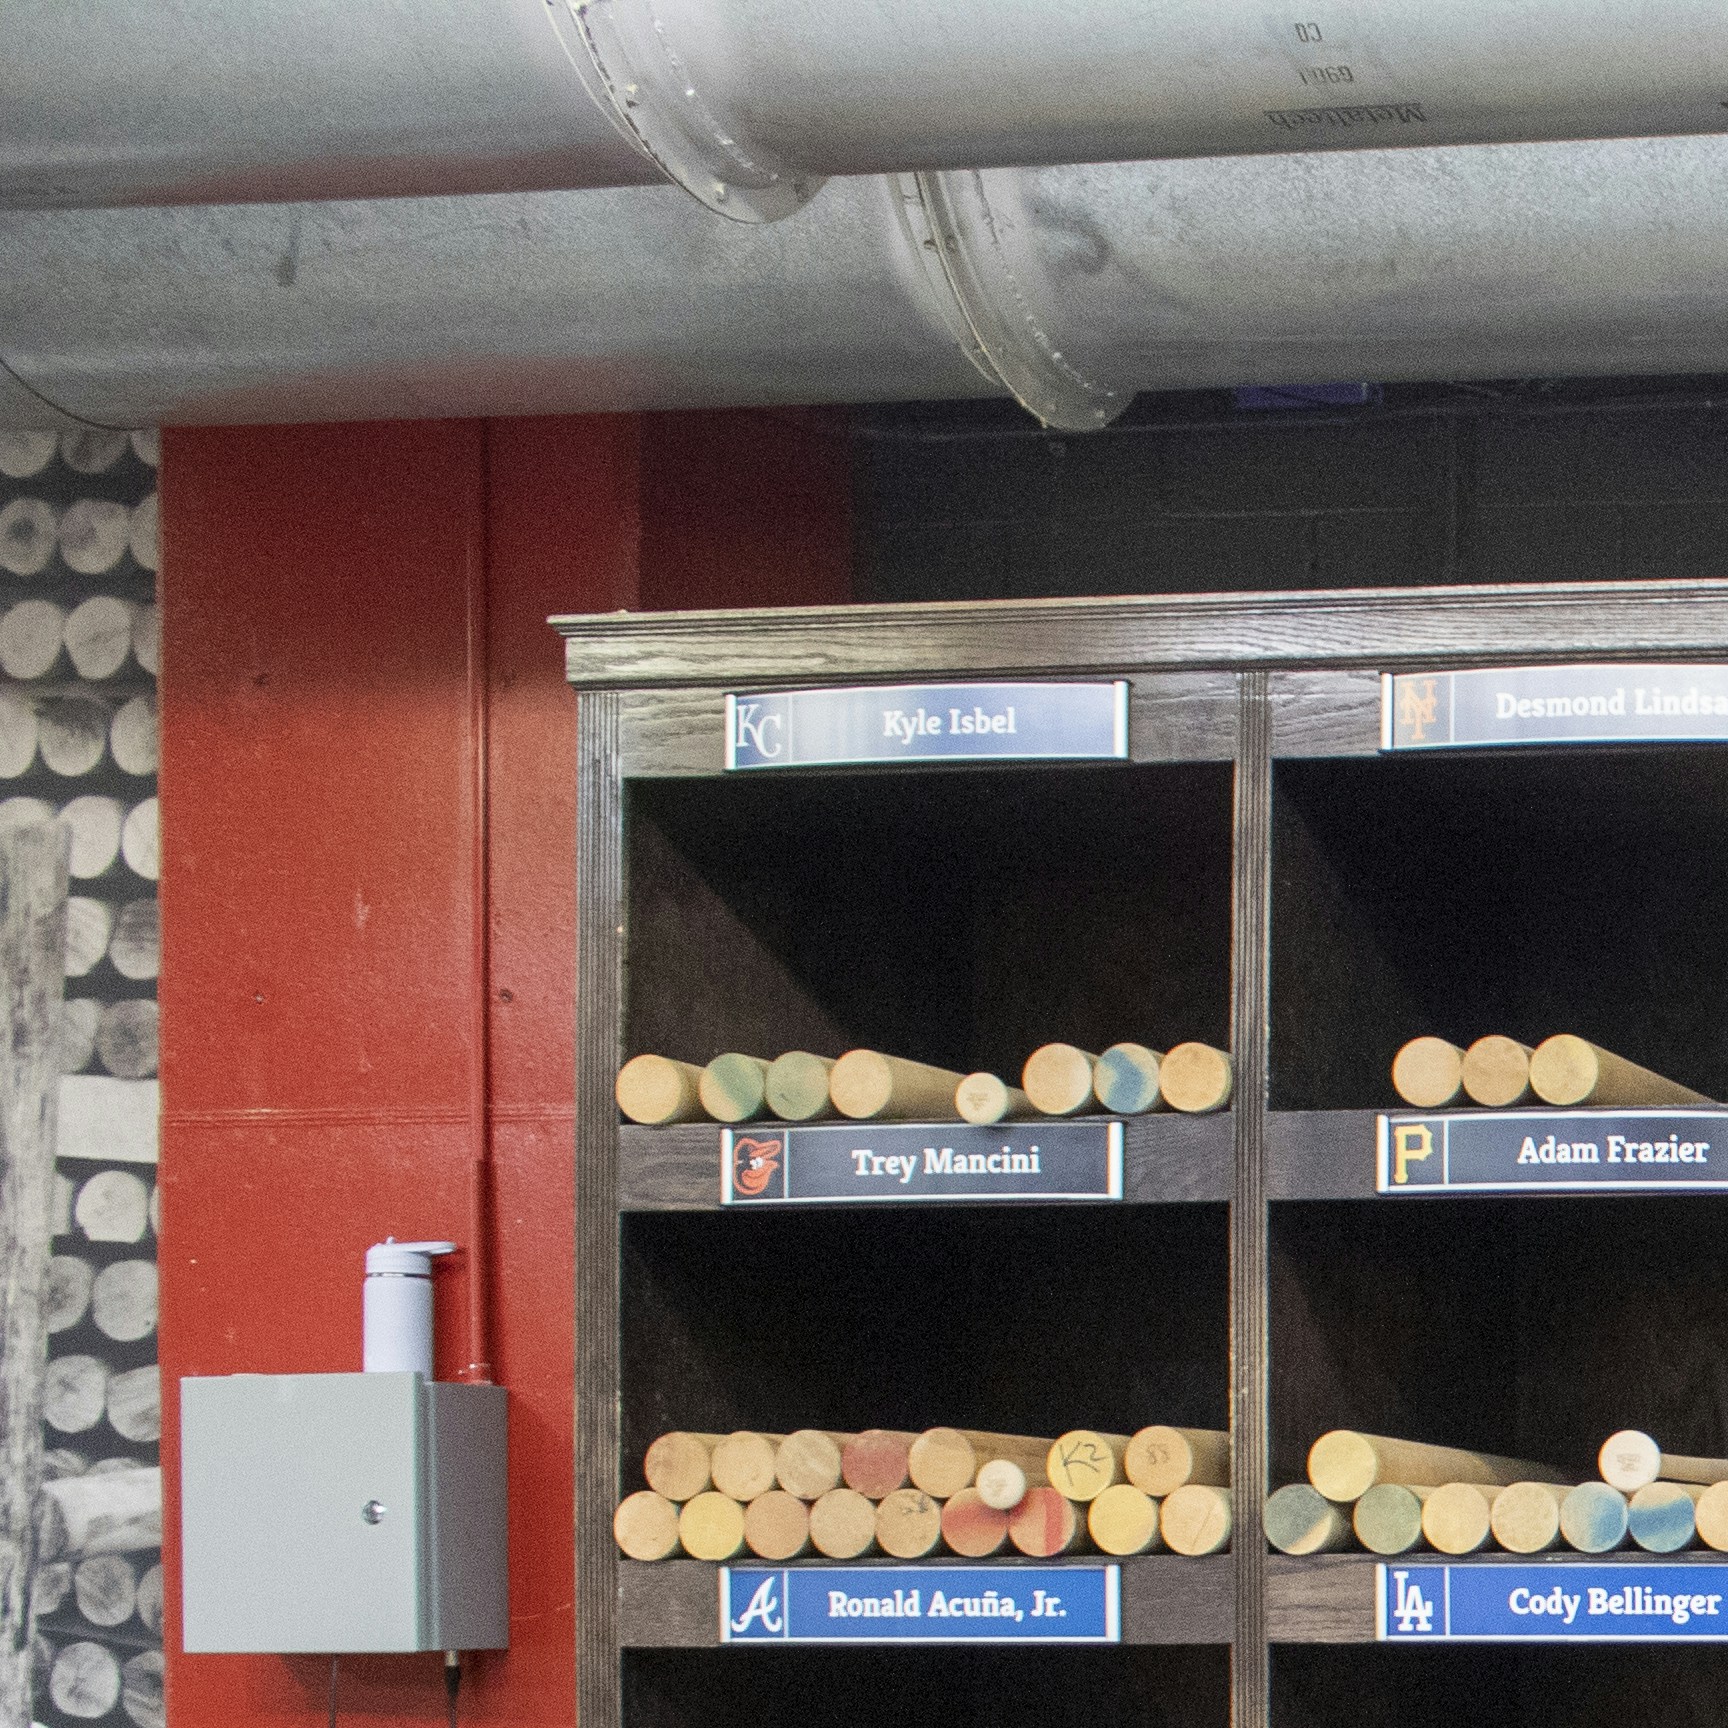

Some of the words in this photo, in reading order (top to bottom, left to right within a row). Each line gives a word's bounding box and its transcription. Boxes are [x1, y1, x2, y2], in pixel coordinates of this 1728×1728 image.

[1496, 686, 1626, 718] Desmond
[882, 706, 940, 740] Kyle
[950, 706, 1016, 734] Isbel
[852, 1149, 911, 1184] Trey
[924, 1146, 1039, 1174] Mancini
[1392, 1124, 1433, 1183] P
[1517, 1135, 1598, 1165] Adam
[1606, 1133, 1710, 1163] Frazier
[828, 1590, 921, 1617] Ronald
[1031, 1590, 1066, 1617] Jr.
[1509, 1587, 1580, 1624] Cody
[1588, 1587, 1722, 1624] Bellinger
